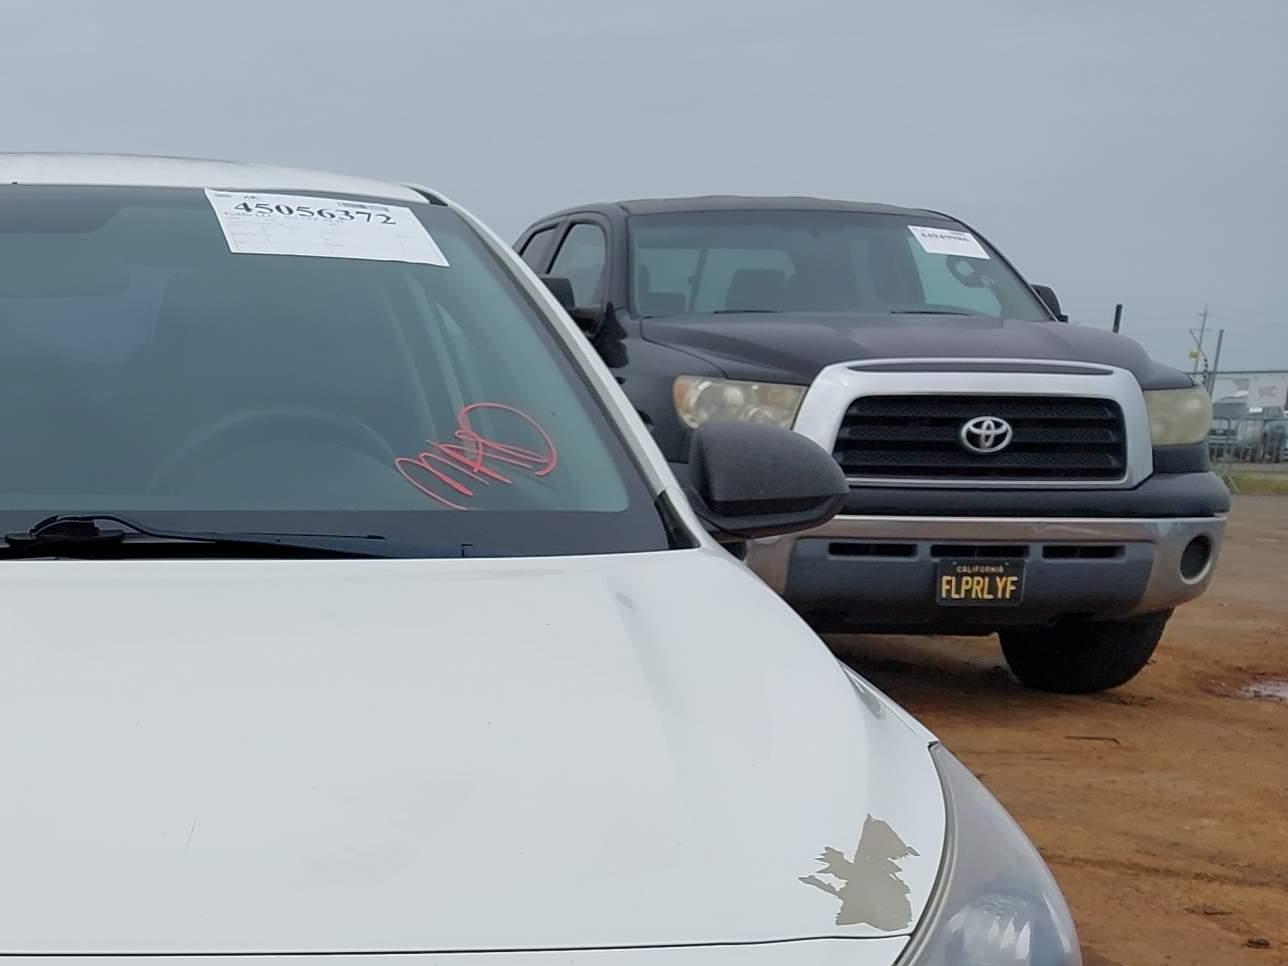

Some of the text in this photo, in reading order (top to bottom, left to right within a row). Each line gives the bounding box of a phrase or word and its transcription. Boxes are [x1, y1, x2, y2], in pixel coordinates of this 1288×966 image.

[233, 202, 397, 225] 45056372
[956, 565, 1004, 573] CALIFORNIA
[941, 575, 1018, 599] FLPRLYF
